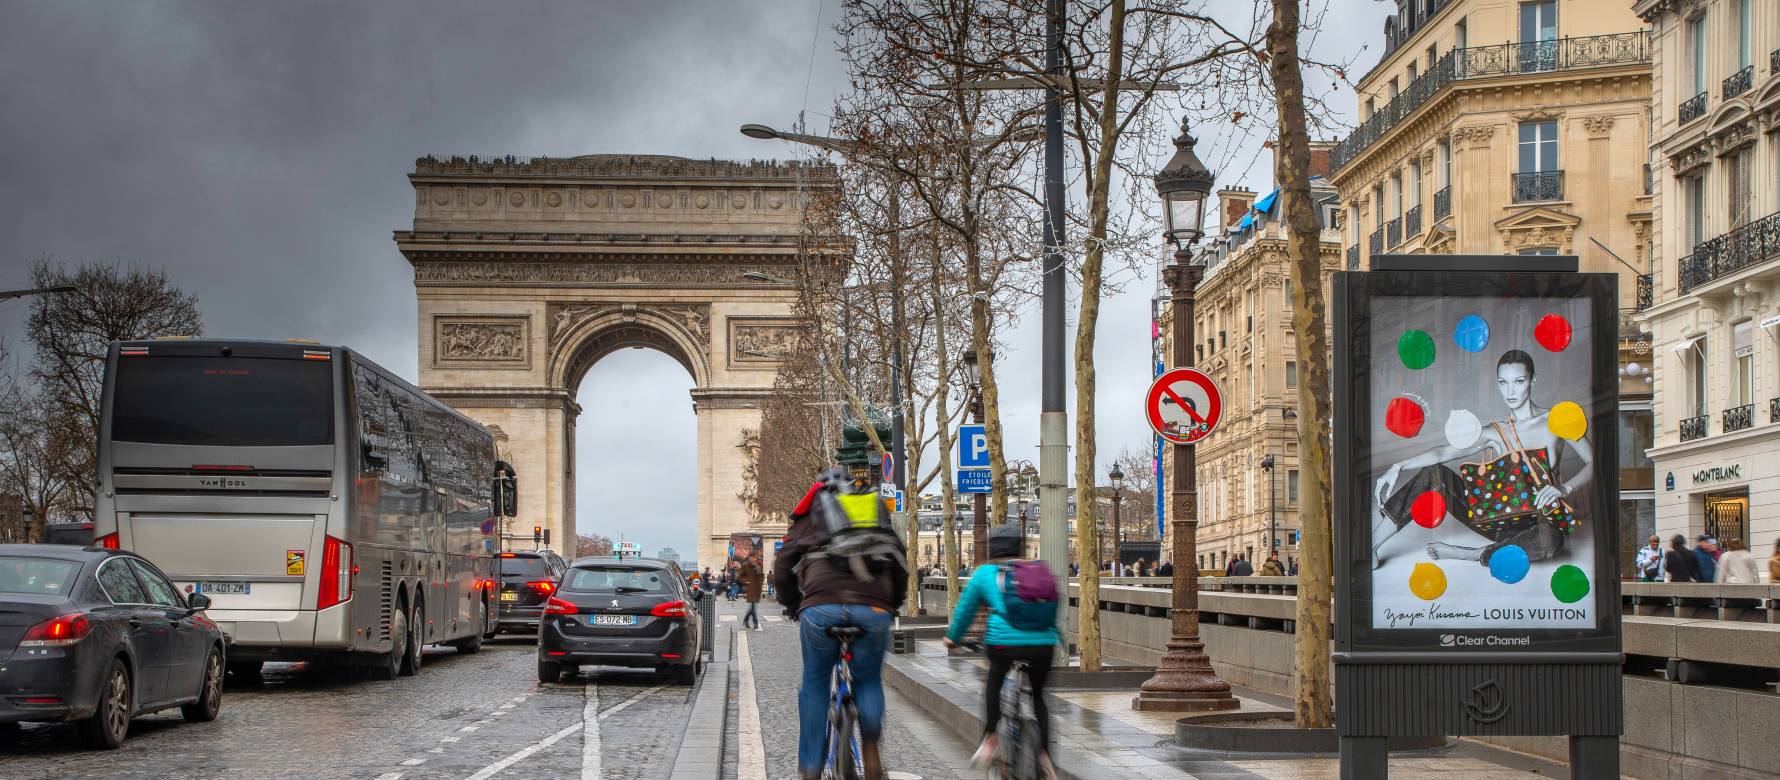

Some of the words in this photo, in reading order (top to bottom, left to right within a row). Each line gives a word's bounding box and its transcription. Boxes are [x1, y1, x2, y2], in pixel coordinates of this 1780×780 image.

[972, 434, 989, 460] P
[1692, 464, 1740, 484] MONTBLANC
[1484, 608, 1524, 620] LOUIS
[1529, 608, 1586, 620] VUITTON
[1456, 635, 1484, 646] Clear
[1486, 635, 1530, 646] Channel
